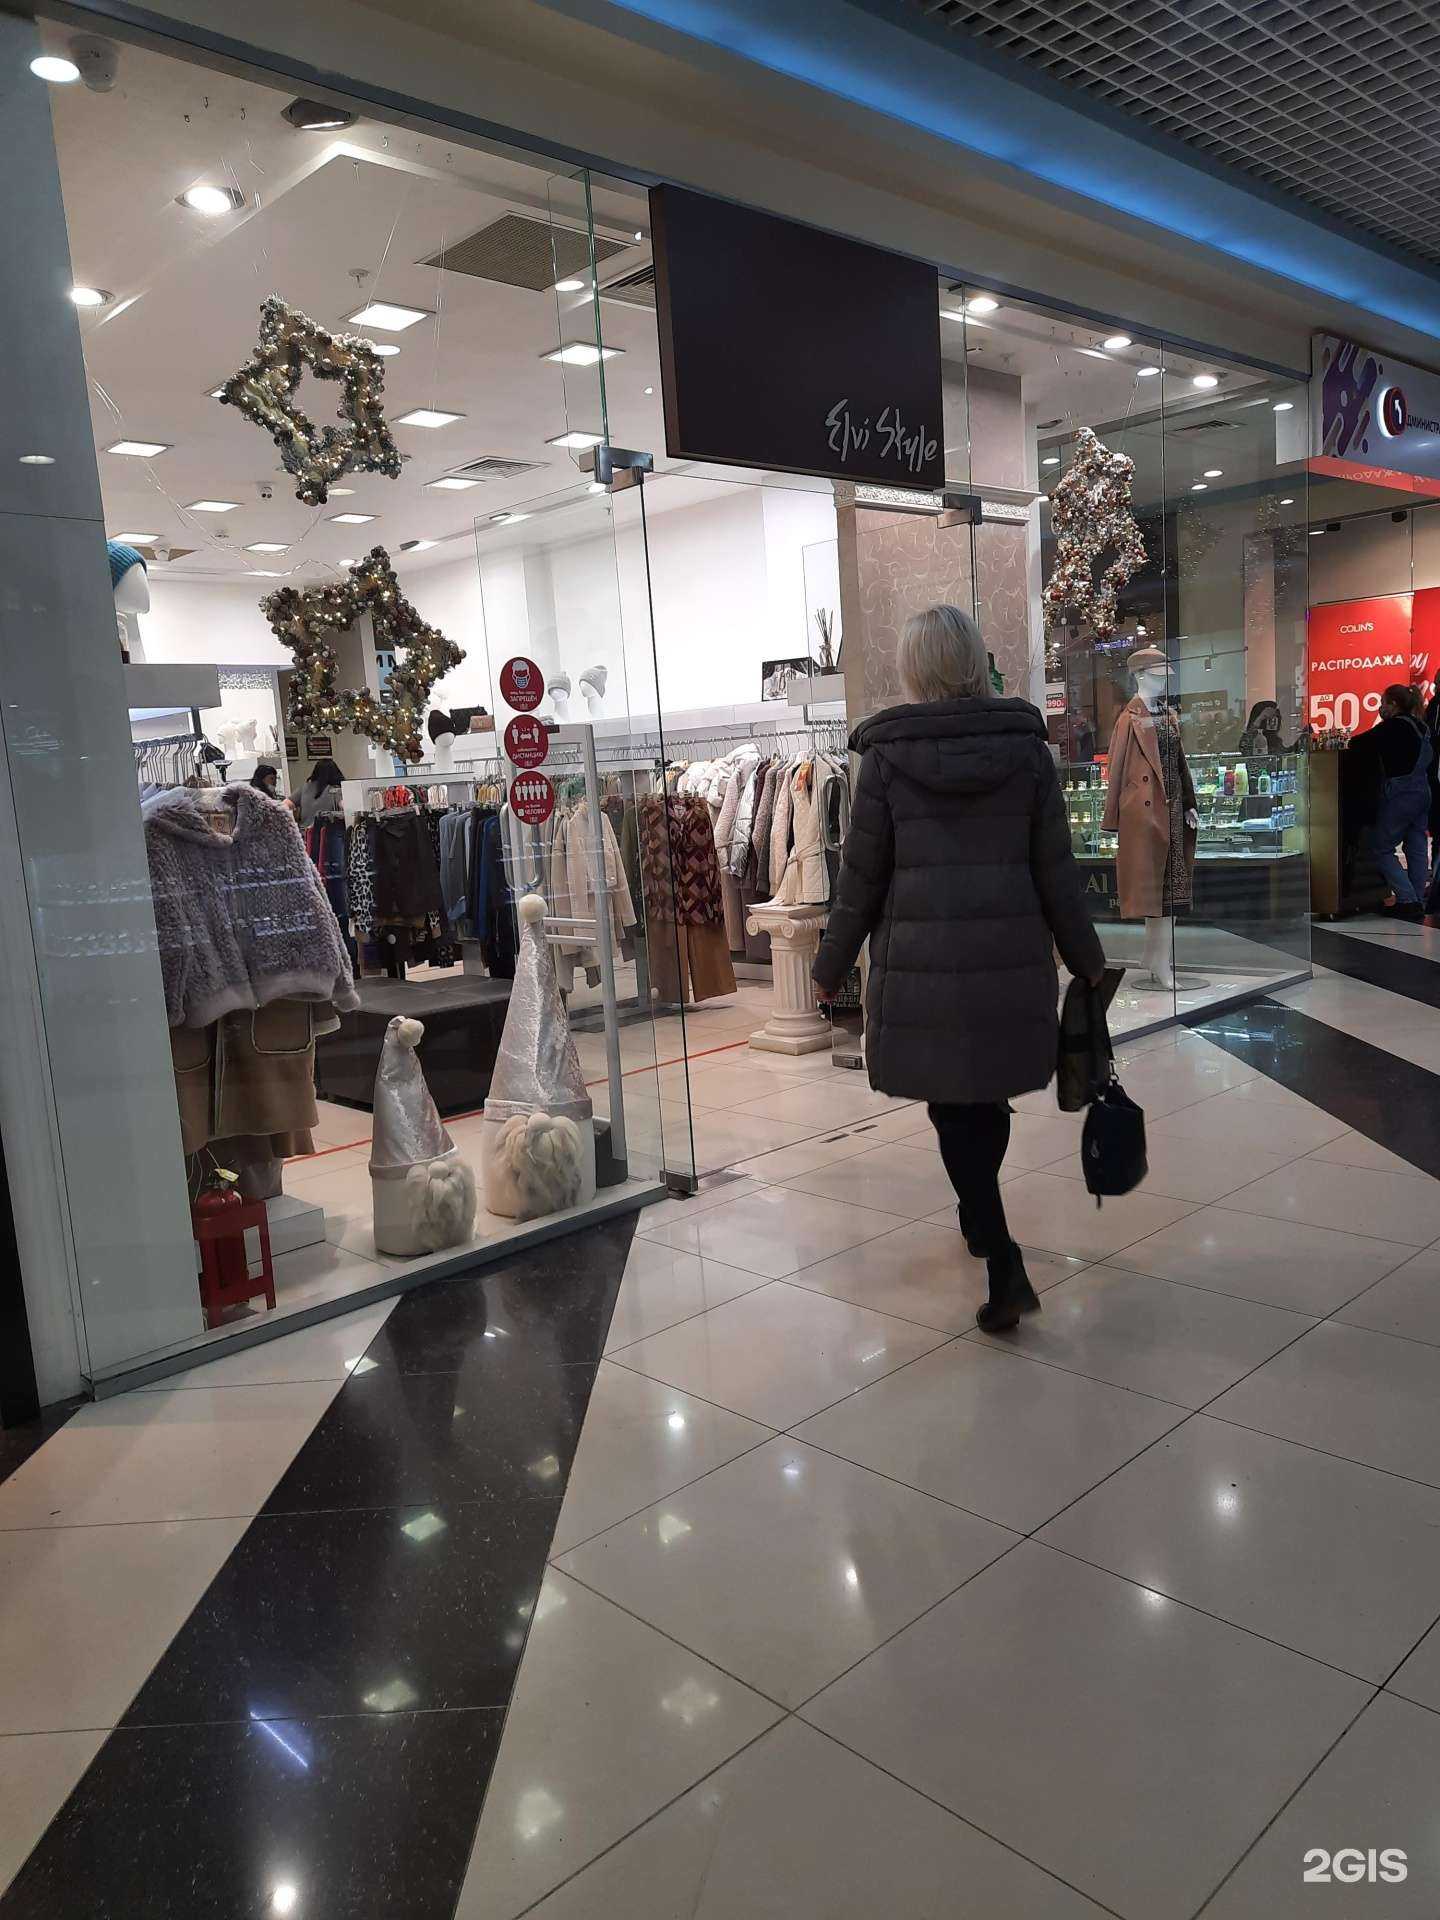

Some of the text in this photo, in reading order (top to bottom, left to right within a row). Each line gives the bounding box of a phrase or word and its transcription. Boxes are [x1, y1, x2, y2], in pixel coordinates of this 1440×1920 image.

[825, 399, 869, 462] Elvi
[1407, 415, 1440, 434] ДМИНИСТР
[1339, 622, 1374, 634] COLIN'S
[1311, 654, 1404, 672] РАСПРОДАЖА
